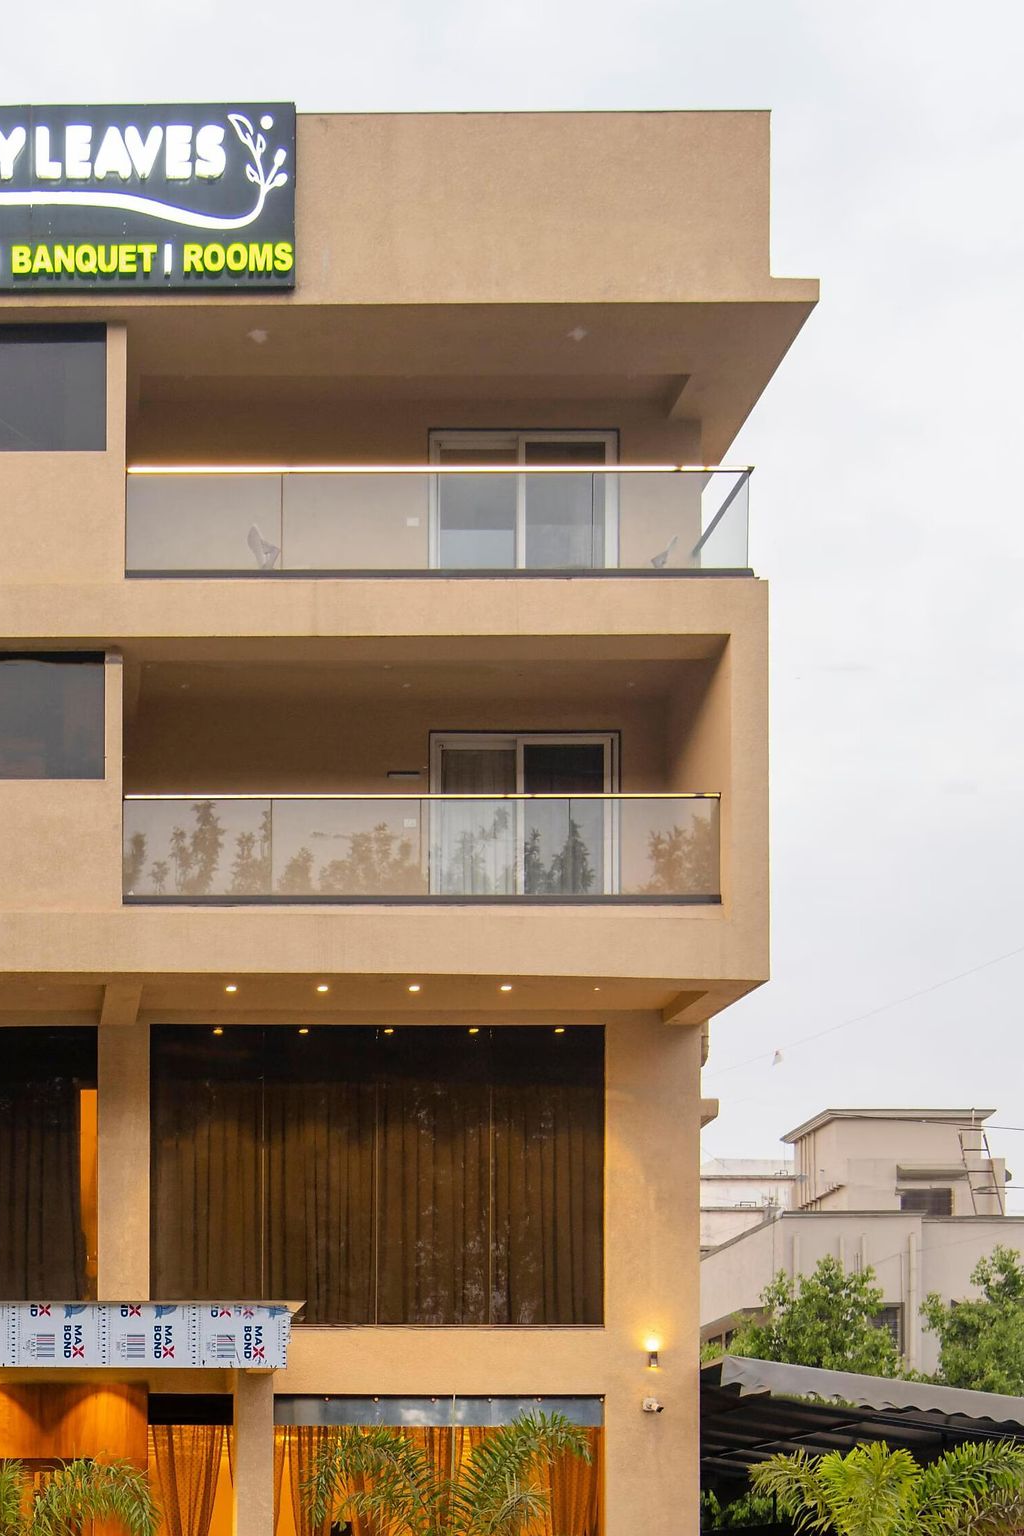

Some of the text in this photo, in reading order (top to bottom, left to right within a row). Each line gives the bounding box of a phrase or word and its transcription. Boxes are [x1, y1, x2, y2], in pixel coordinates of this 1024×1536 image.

[35, 124, 227, 180] LEAVES
[11, 244, 158, 275] BANQUET
[183, 243, 293, 273] ROOMS
[63, 1325, 72, 1358] BOND
[72, 1325, 84, 1358] MAX
[154, 1325, 162, 1359] BOND
[162, 1326, 174, 1358] MAX
[244, 1326, 252, 1359] BOND
[253, 1326, 265, 1359] MAX
